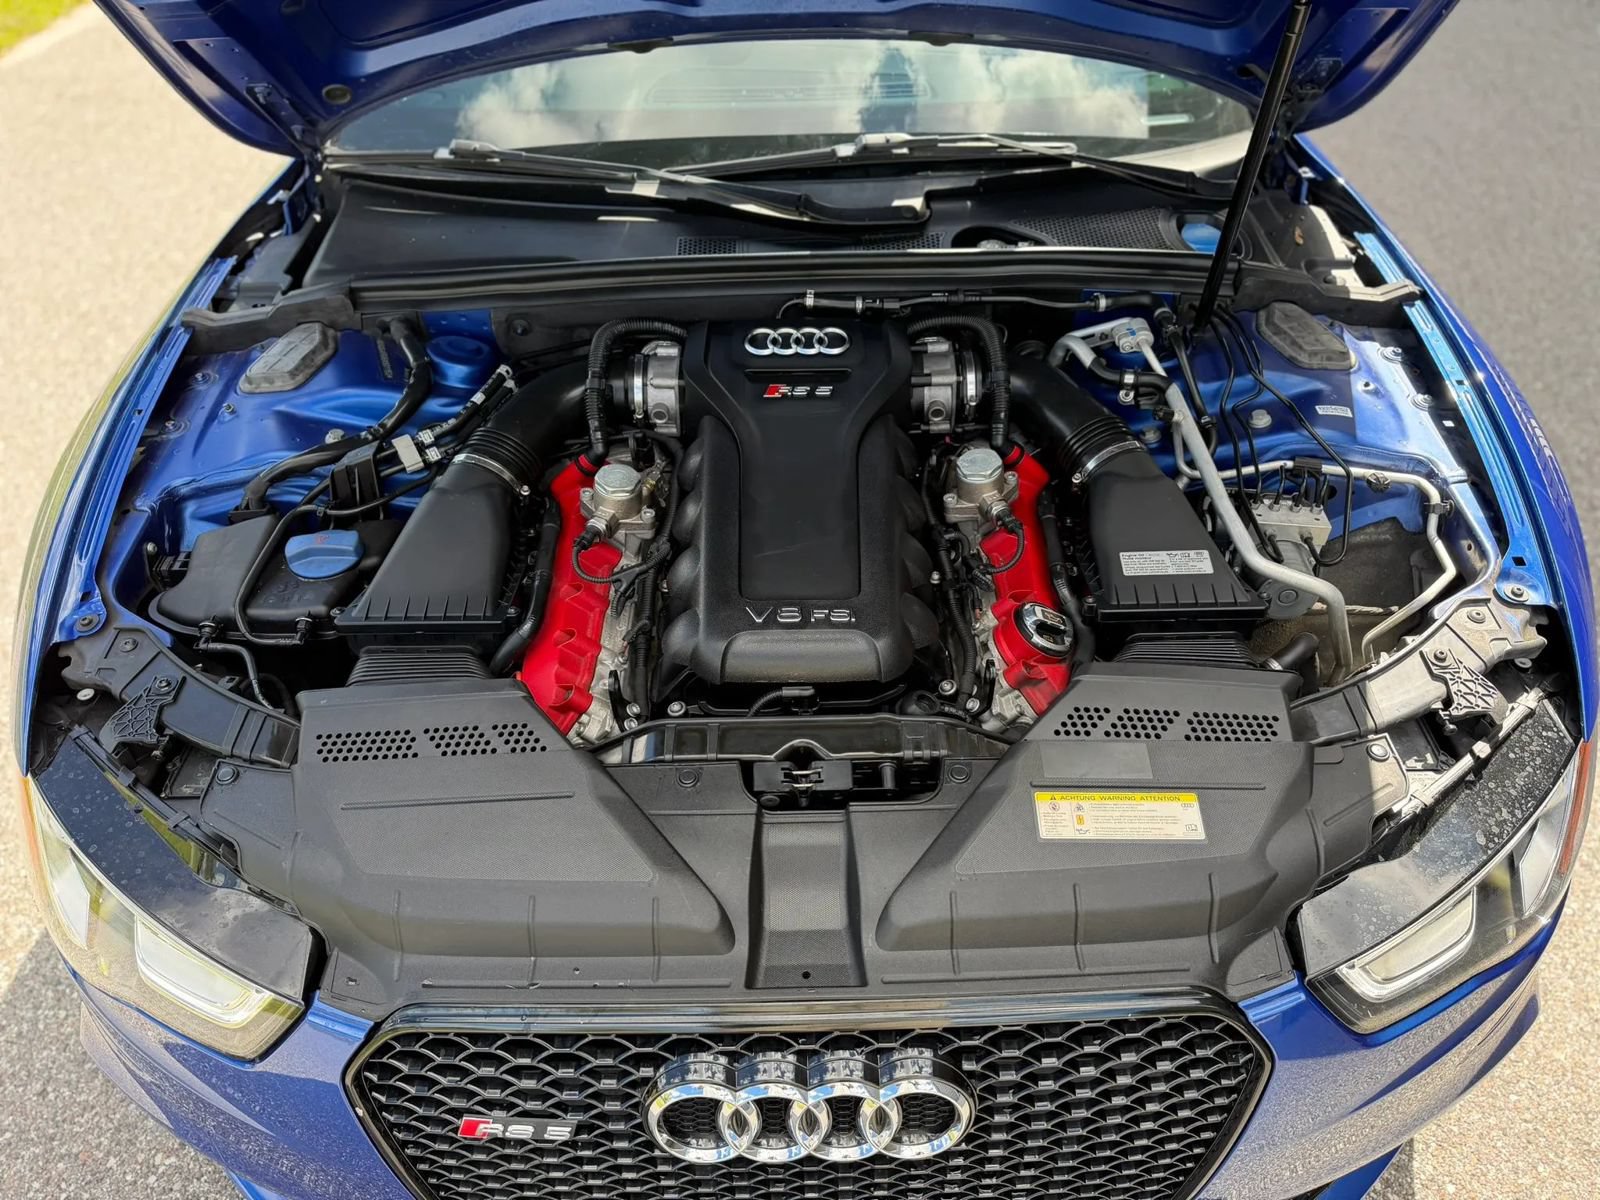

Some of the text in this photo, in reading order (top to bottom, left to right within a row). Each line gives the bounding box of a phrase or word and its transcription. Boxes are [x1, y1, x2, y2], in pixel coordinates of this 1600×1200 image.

[773, 385, 810, 396] RS
[745, 606, 802, 622] V8
[475, 1123, 572, 1140] RS 5
